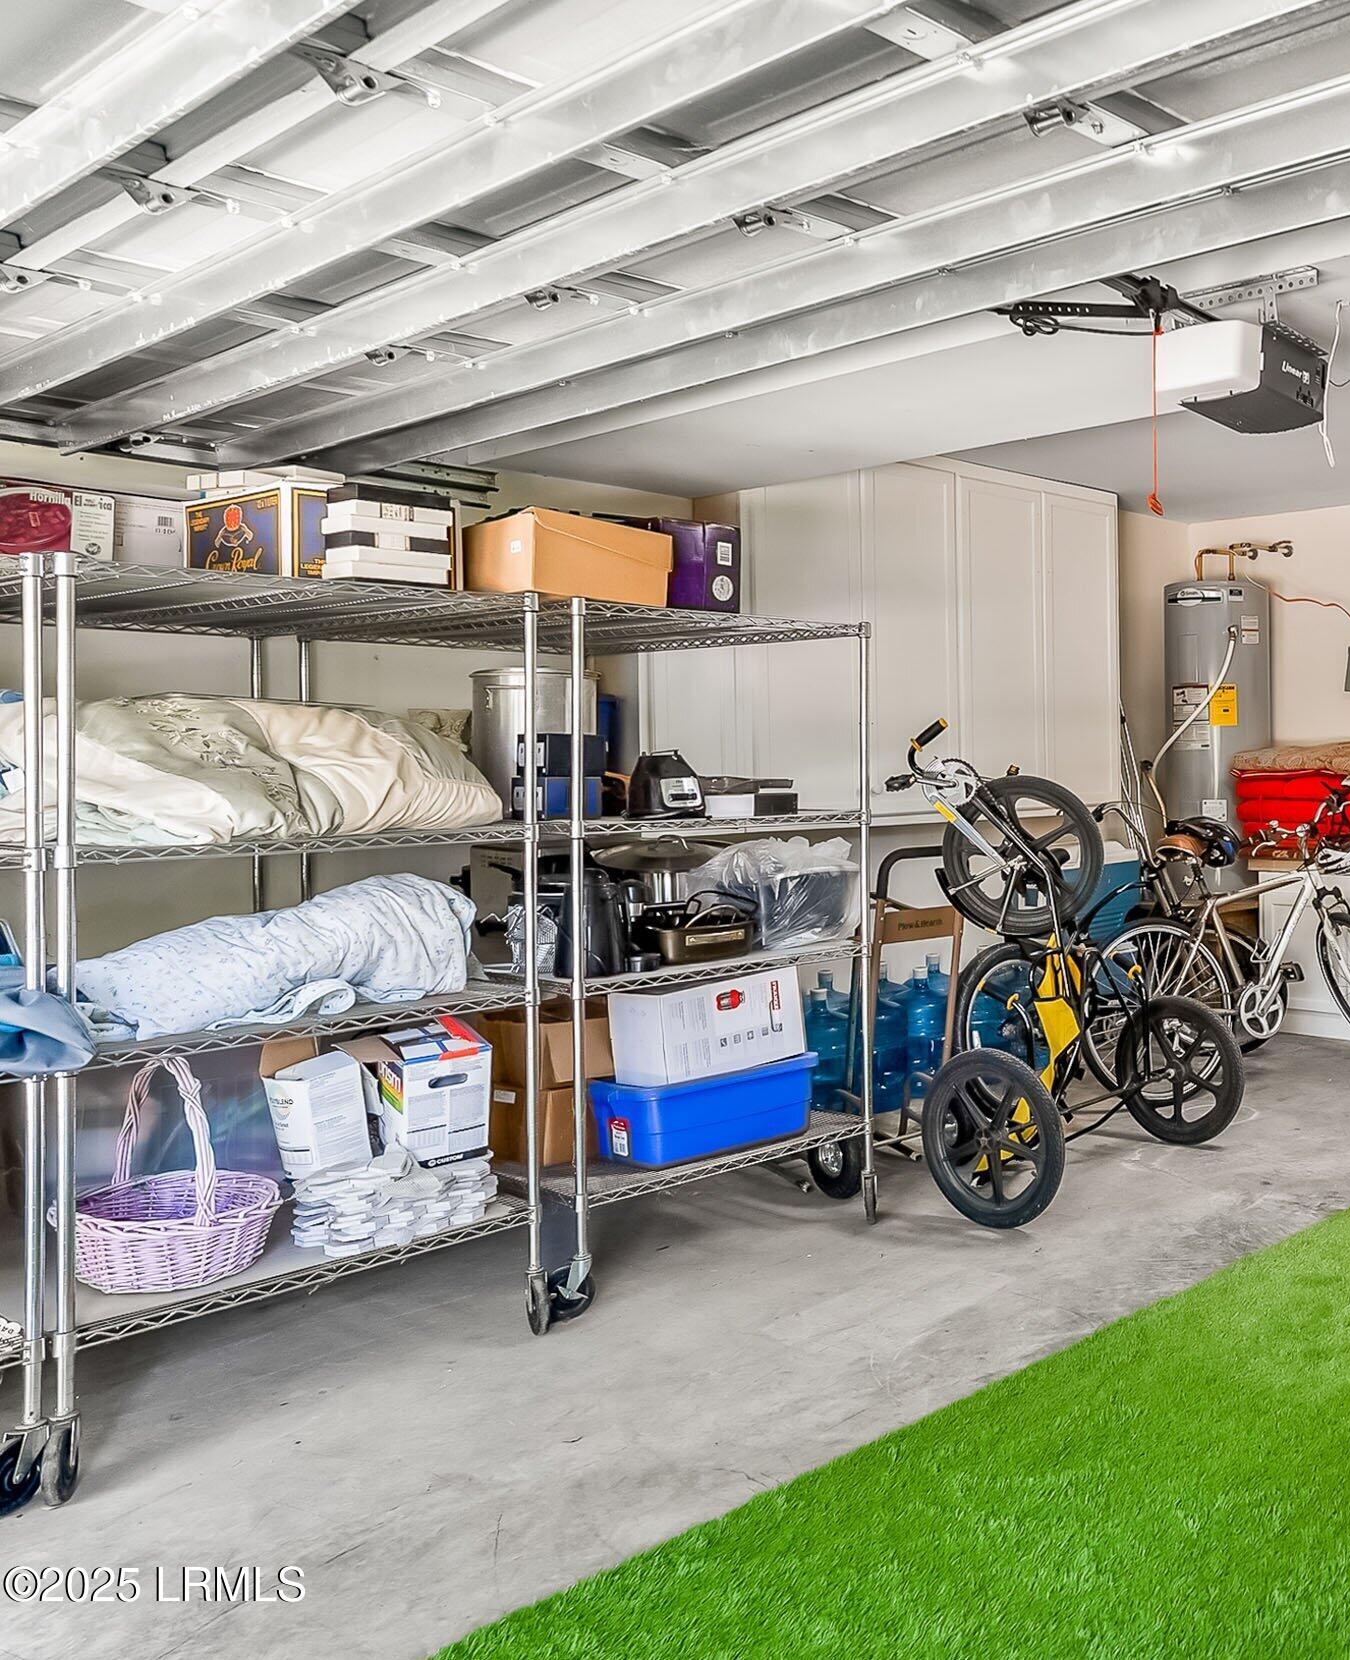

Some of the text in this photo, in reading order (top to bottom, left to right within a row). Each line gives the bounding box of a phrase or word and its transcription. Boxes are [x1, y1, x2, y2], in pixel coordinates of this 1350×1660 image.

[1281, 360, 1303, 379] Linear
[29, 491, 73, 505] Hornilla
[205, 547, 263, 573] Crown Royal
[436, 1153, 464, 1165] CUSTOM
